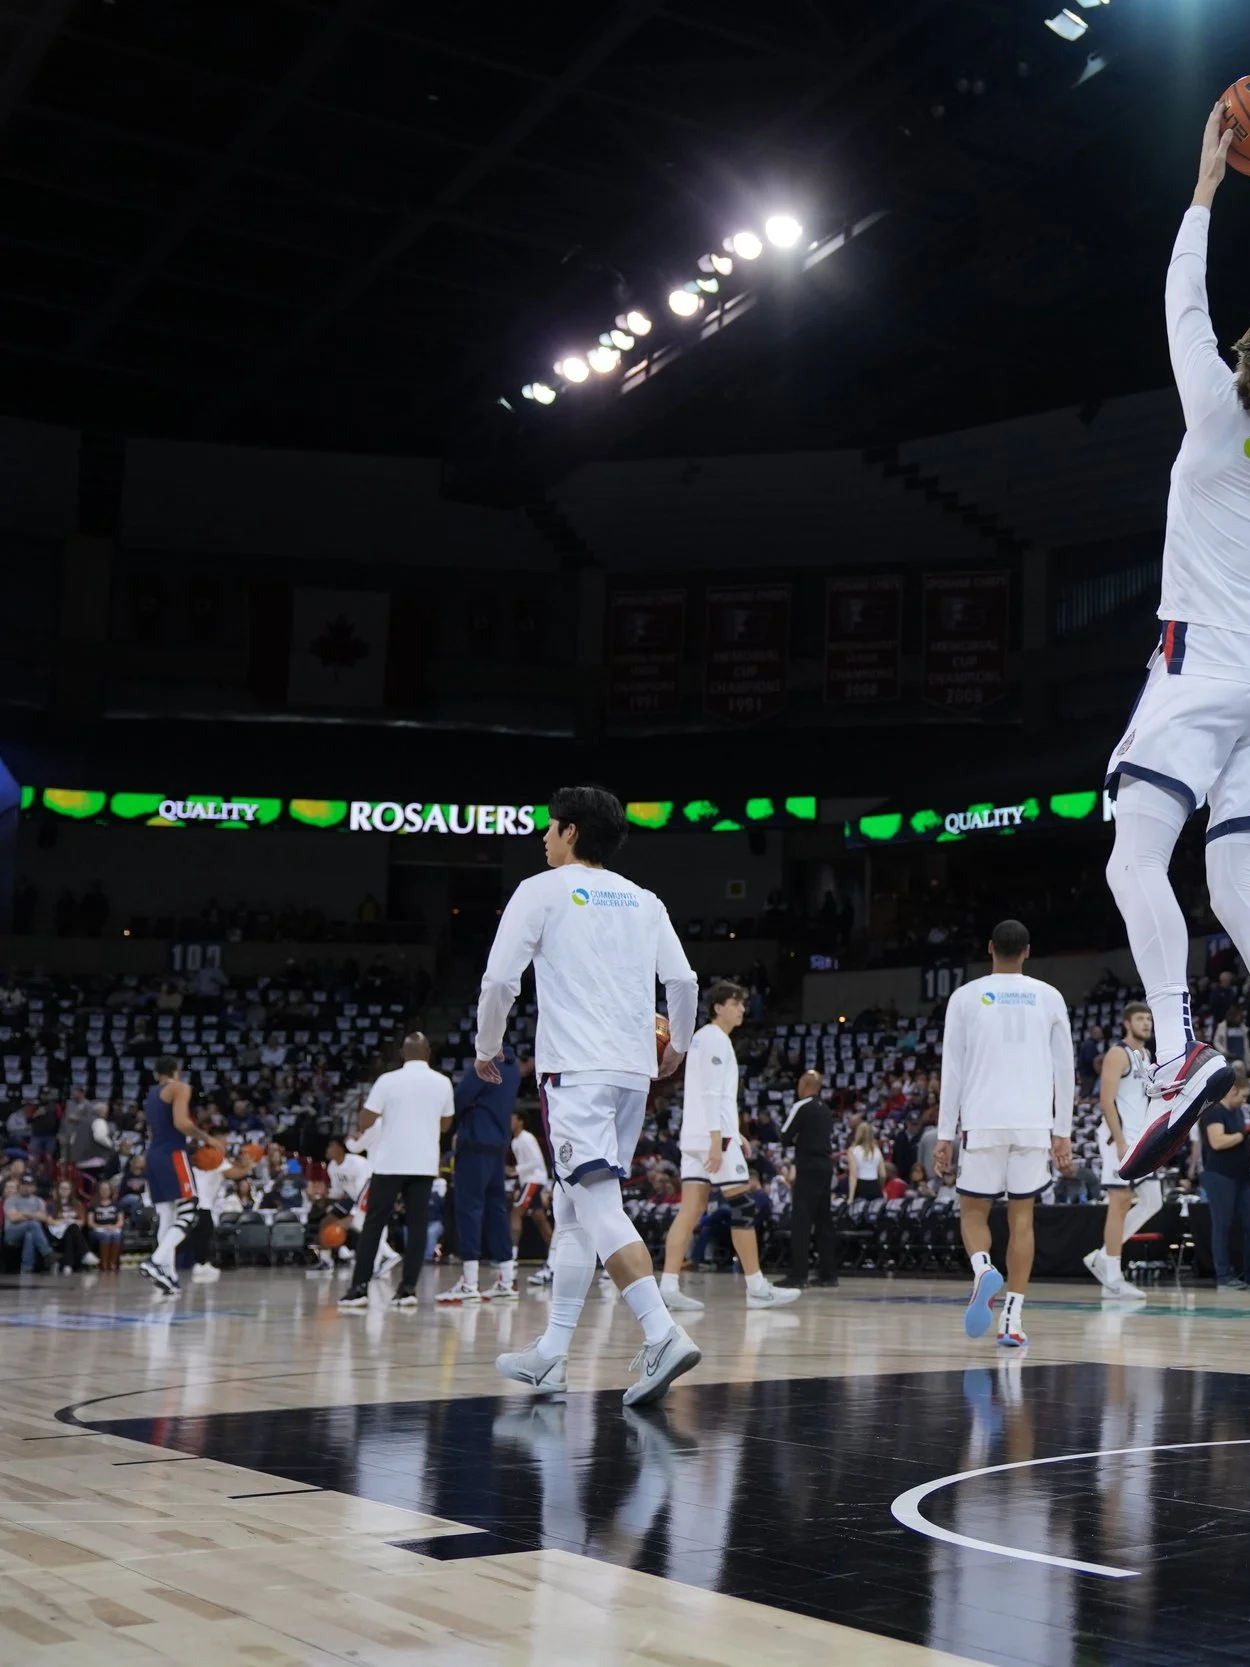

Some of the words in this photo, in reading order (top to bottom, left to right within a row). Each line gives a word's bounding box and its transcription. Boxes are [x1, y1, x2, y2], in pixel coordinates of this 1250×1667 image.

[952, 655, 978, 669] CUP
[158, 800, 260, 821] QUALITY
[349, 801, 535, 835] ROSAUERS
[944, 806, 1026, 834] QUALITY
[590, 890, 637, 900] COMMUNITY
[925, 967, 964, 999] 107
